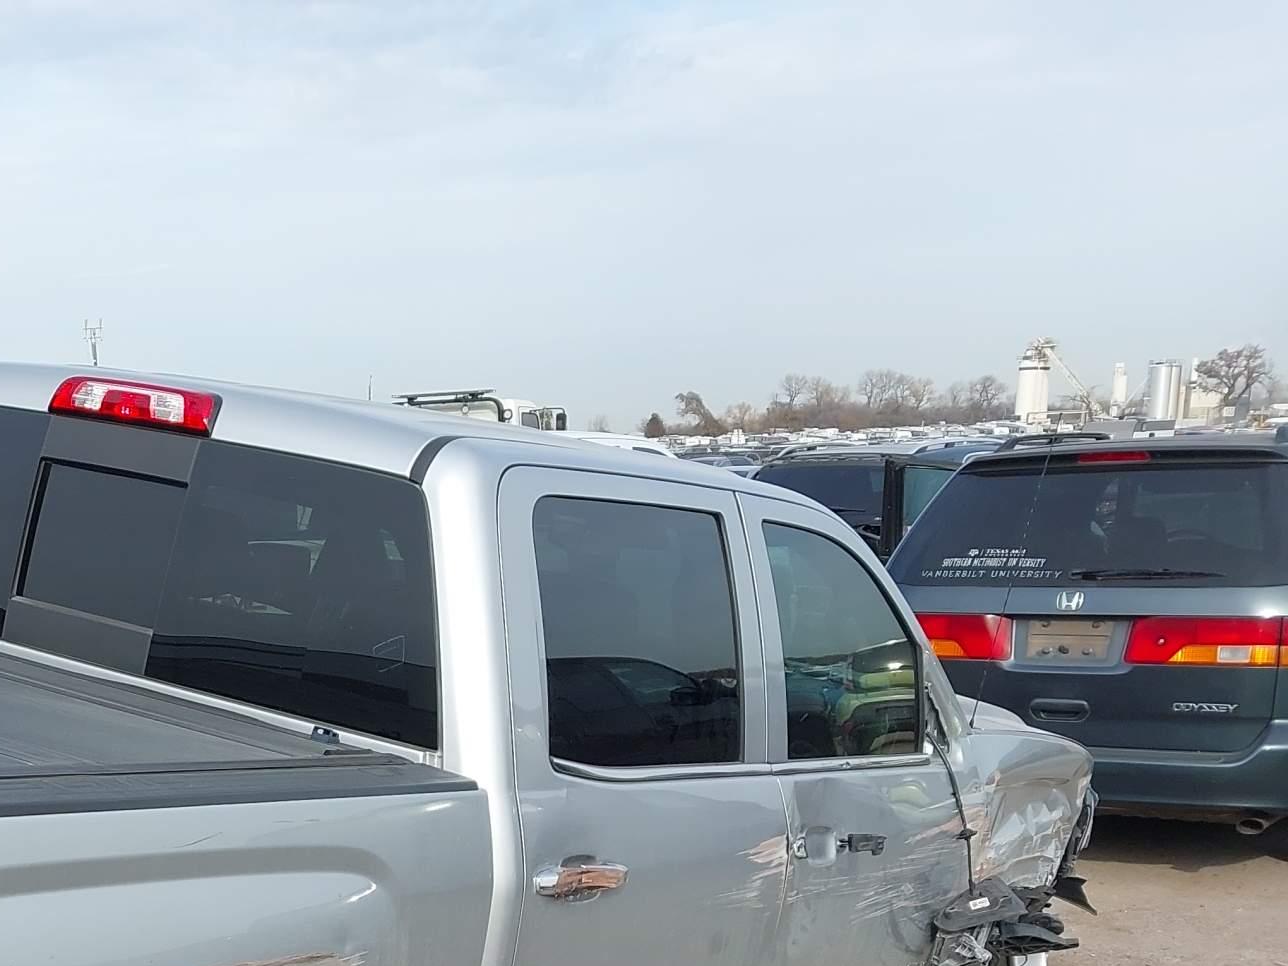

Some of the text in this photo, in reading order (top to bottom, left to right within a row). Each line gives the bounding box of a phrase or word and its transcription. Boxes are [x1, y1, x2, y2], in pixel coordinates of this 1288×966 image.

[972, 558, 1006, 567] METHODIST
[1007, 558, 1046, 567] UNVERSITY
[921, 570, 1062, 578] VANDERBILT UNIVERSITY
[1173, 702, 1239, 712] ODYSSEY
